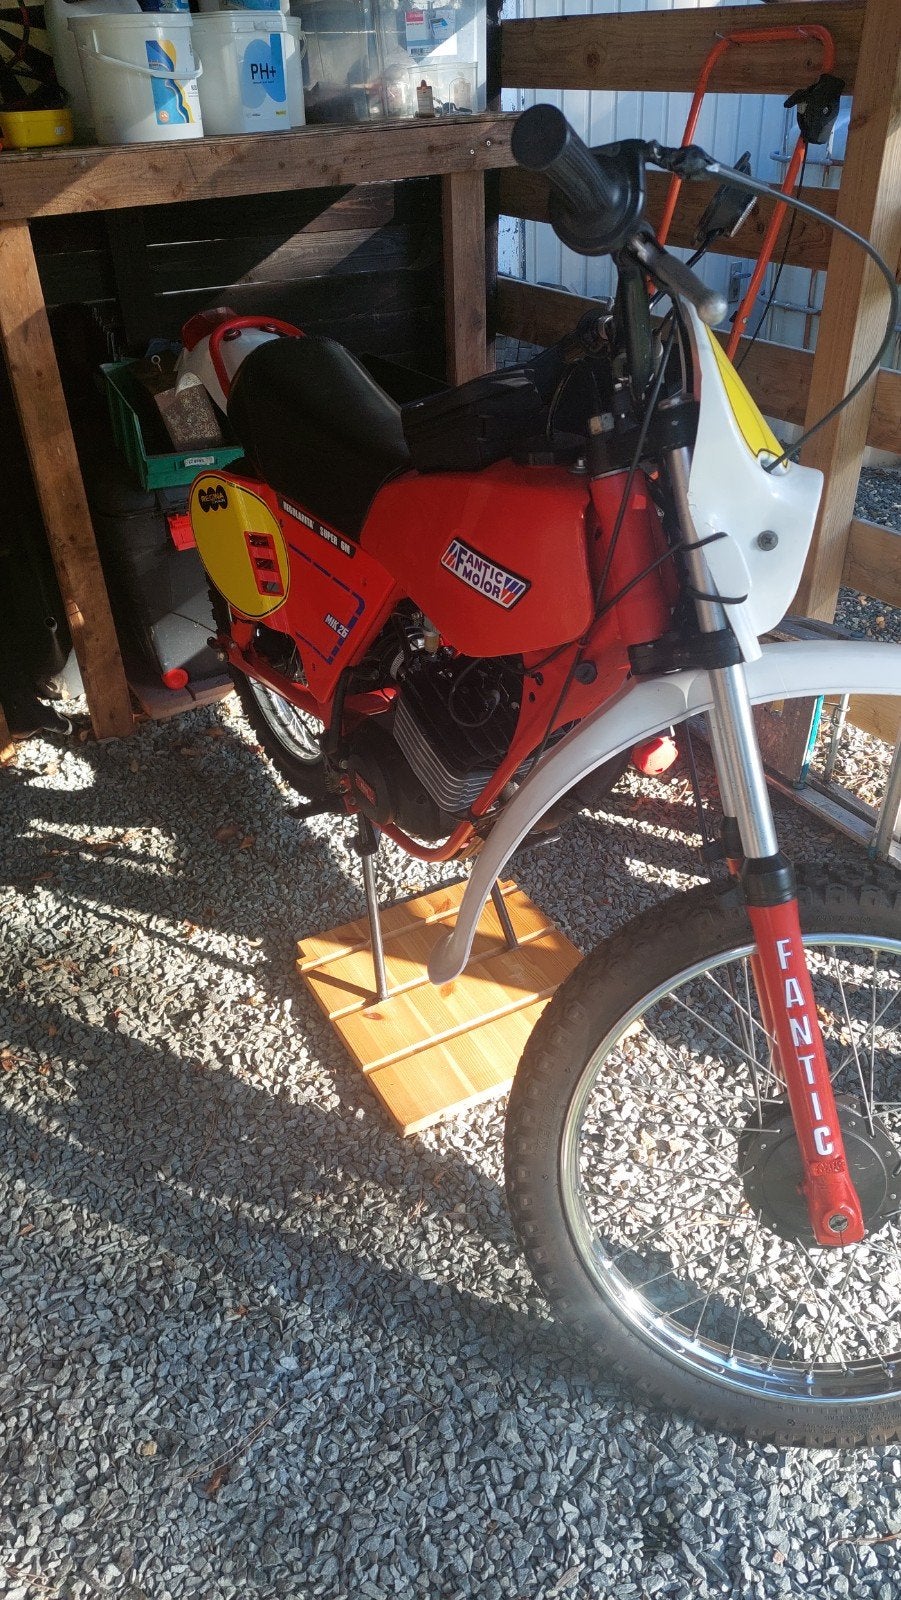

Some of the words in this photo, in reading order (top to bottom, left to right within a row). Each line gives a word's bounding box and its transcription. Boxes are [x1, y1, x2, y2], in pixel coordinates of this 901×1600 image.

[250, 63, 277, 80] PH+
[319, 526, 338, 546] SUPER
[454, 546, 503, 584] FANTIC
[462, 565, 500, 599] MOTOR
[336, 624, 350, 638] 26
[776, 938, 834, 1157] FANTIC
